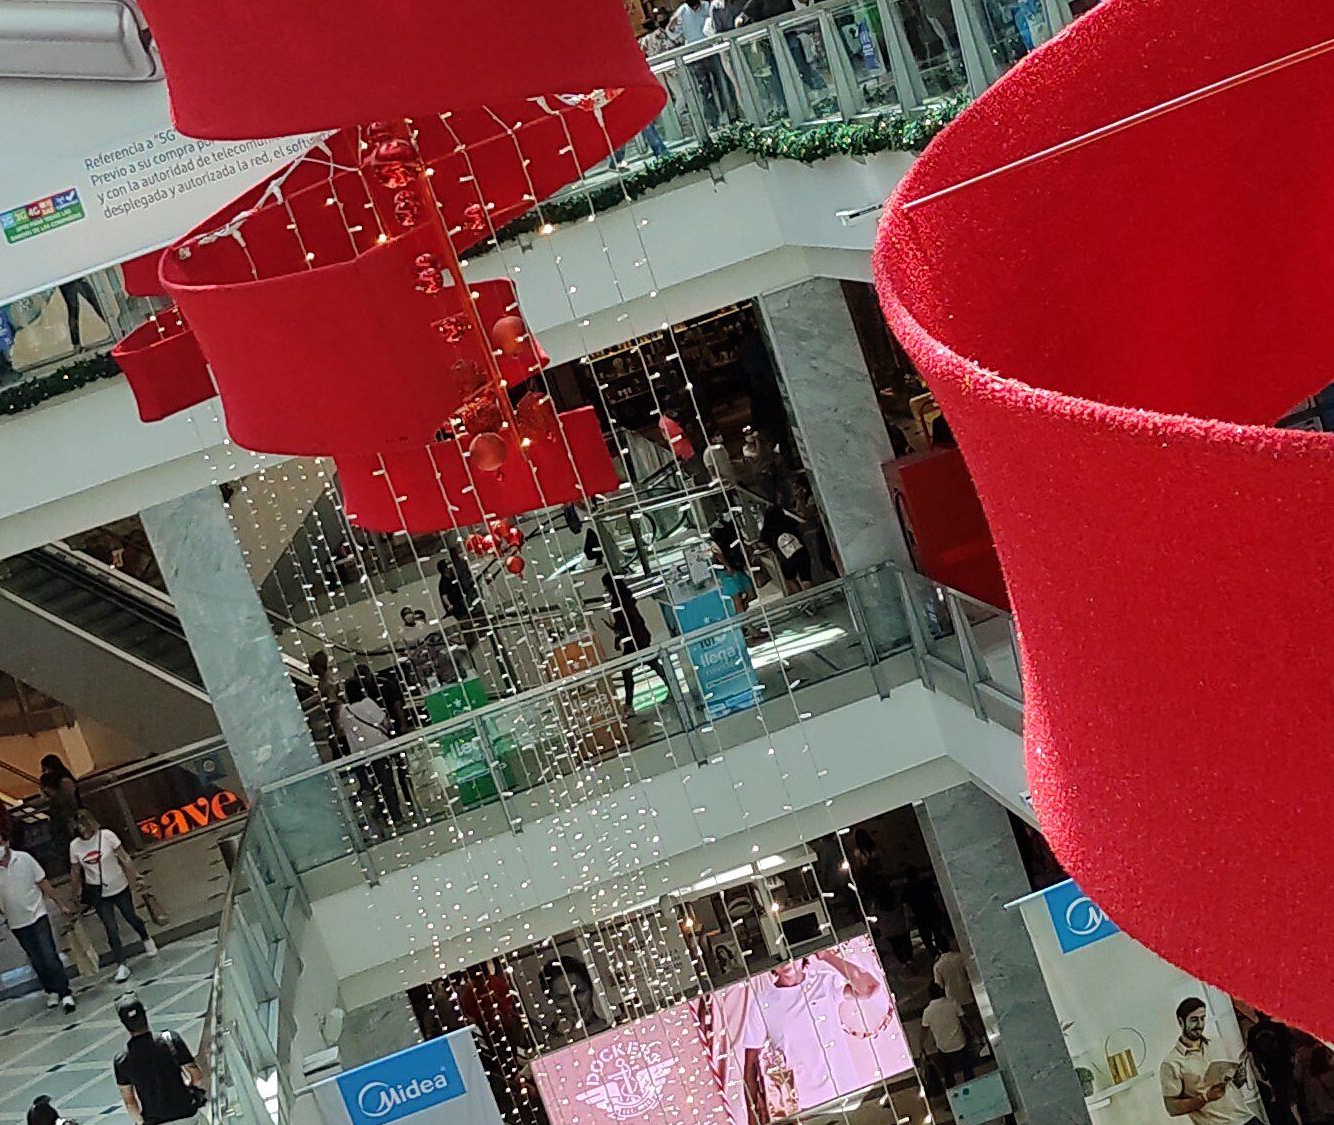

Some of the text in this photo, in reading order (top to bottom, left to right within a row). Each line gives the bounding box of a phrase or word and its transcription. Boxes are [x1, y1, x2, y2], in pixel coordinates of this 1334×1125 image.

[85, 142, 144, 170] Referencia
[146, 140, 154, 149] a
[90, 167, 127, 186] Previo
[129, 164, 136, 173] a
[138, 159, 151, 170] su
[153, 143, 195, 164] compra
[97, 192, 104, 205] y
[107, 185, 127, 199] con
[127, 180, 140, 191] la
[141, 159, 195, 187] autoridad
[196, 155, 211, 168] de
[104, 188, 167, 218] desplegada
[168, 186, 176, 199] y
[177, 164, 236, 193] autorizada
[236, 159, 249, 171] la
[273, 146, 285, 159] el
[358, 1074, 447, 1117] Midea
